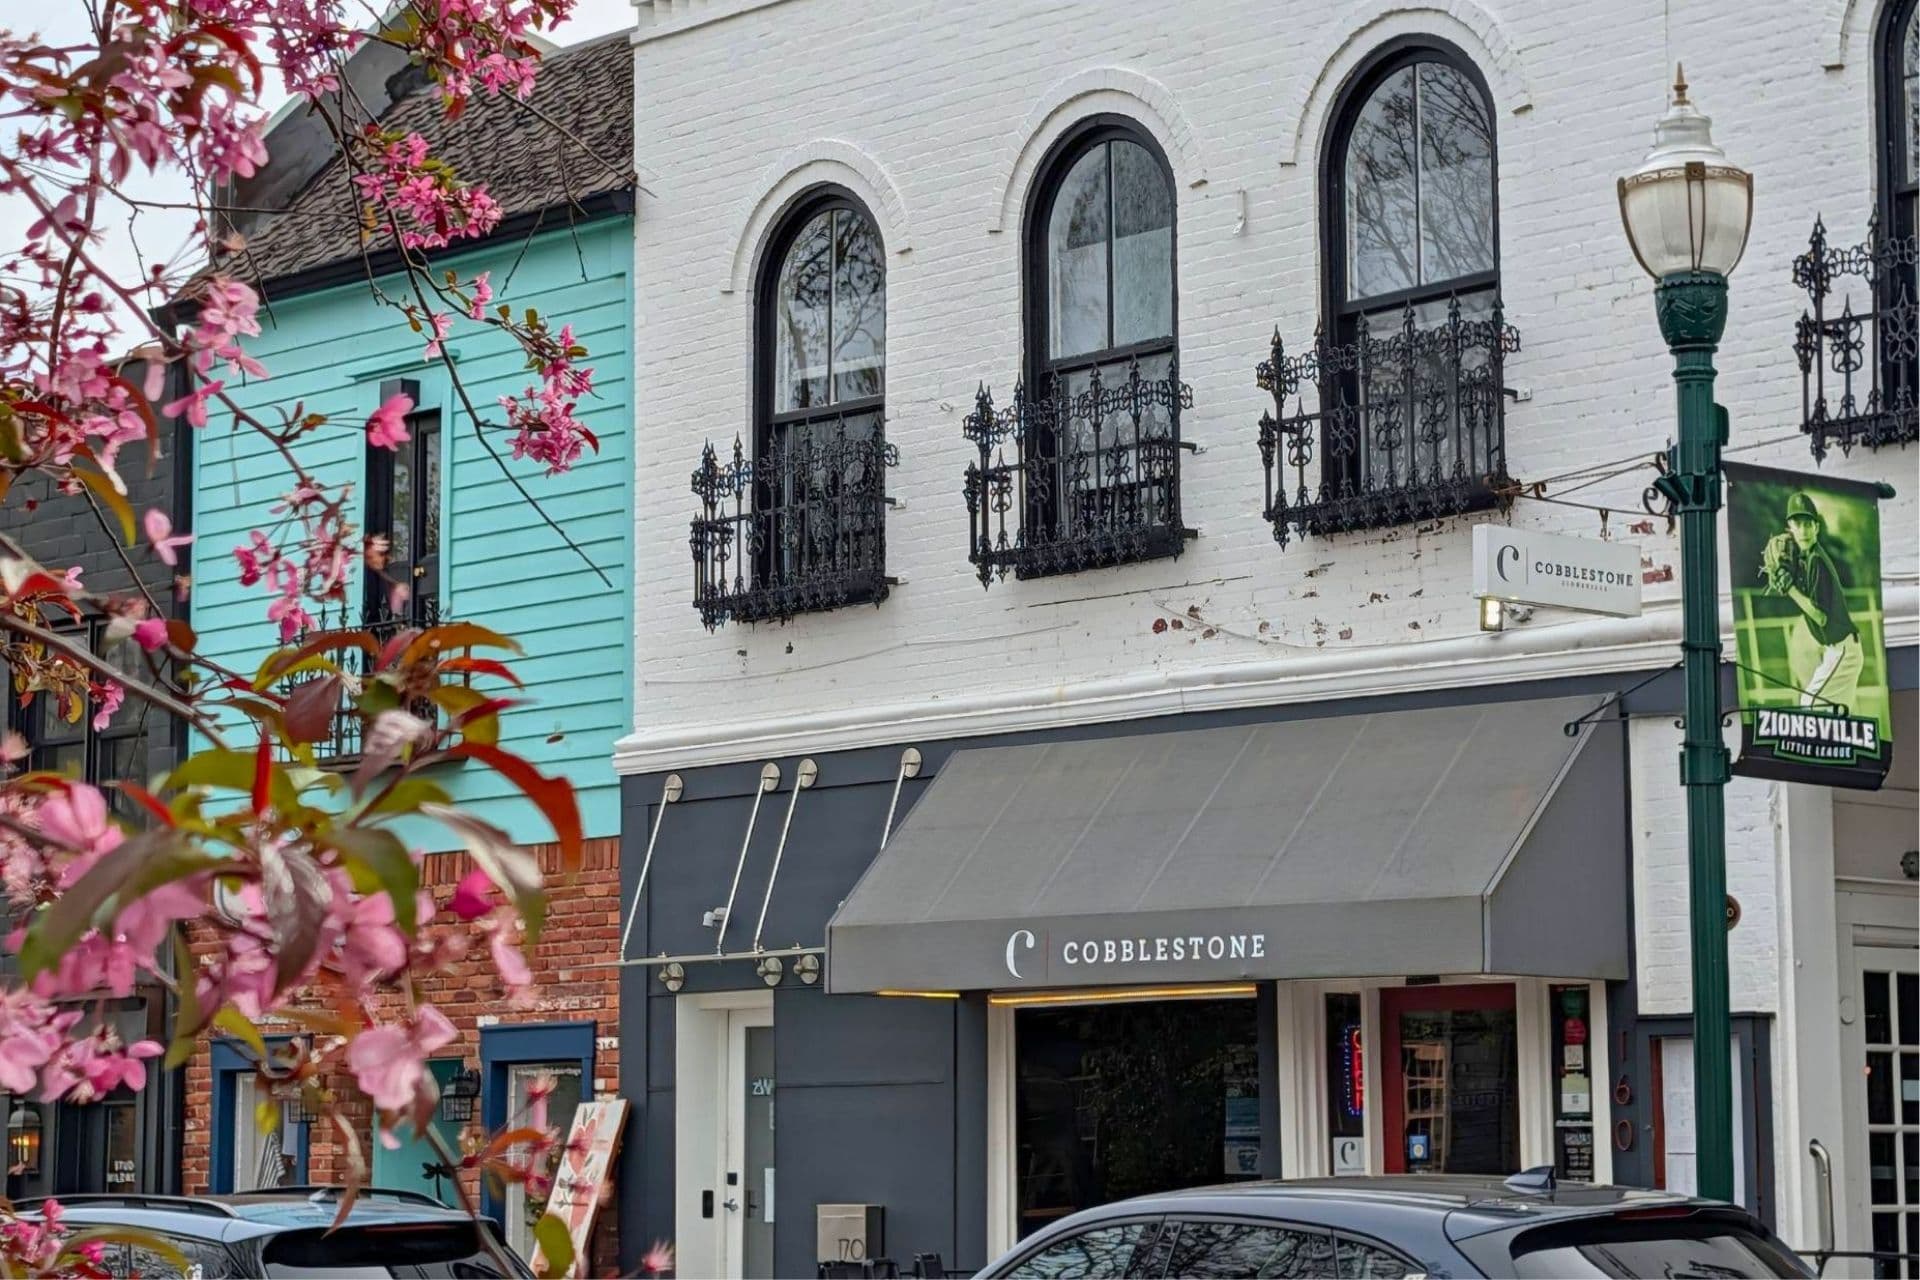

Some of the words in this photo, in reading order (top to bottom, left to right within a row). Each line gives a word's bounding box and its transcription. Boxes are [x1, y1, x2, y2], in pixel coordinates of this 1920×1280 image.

[1535, 561, 1634, 587] COBBLESTONE
[1758, 710, 1876, 750] ZIONSVILLE
[1781, 740, 1811, 756] LITTLE
[1815, 746, 1852, 758] LEAGUE
[1063, 934, 1265, 964] COBBLESTONE
